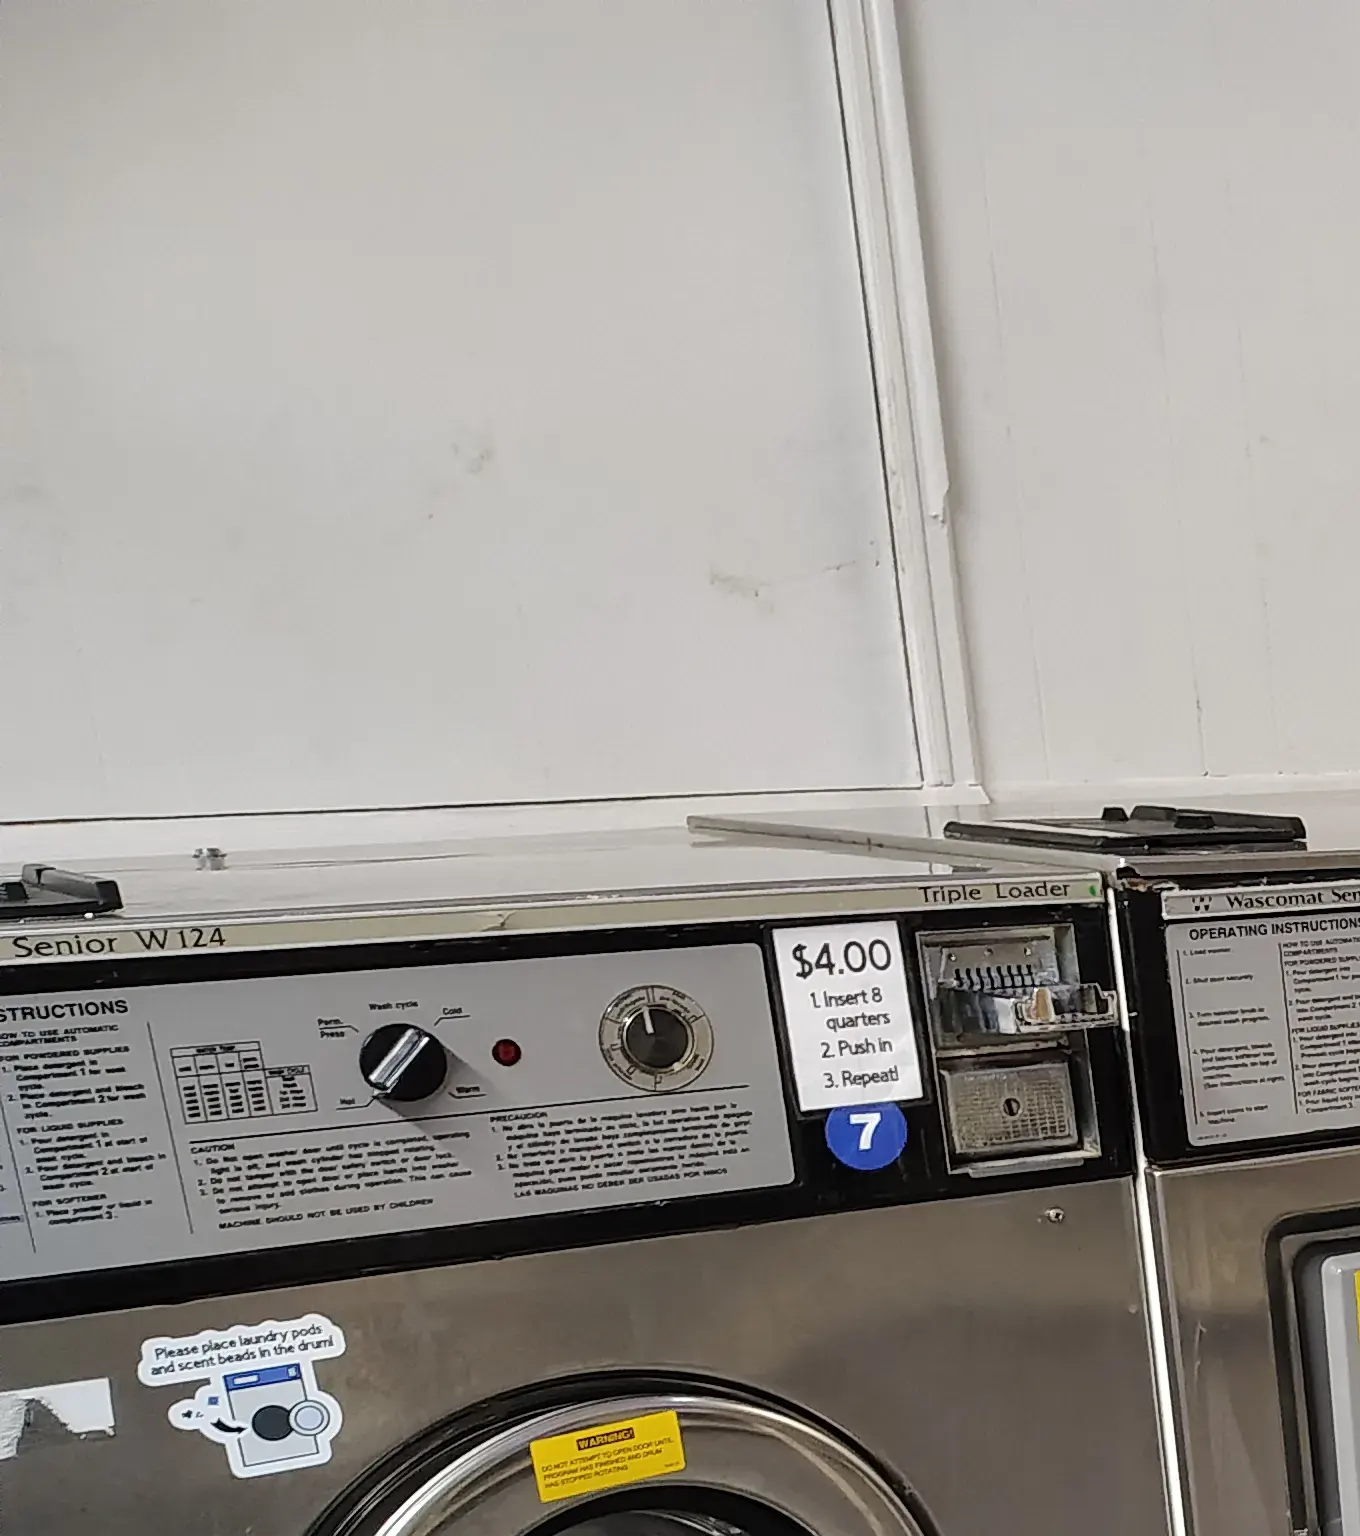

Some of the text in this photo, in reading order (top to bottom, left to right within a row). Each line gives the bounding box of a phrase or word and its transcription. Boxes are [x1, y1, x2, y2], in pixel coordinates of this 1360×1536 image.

[918, 881, 1071, 905] Triple Loader
[1226, 891, 1324, 910] Wascomat
[12, 927, 227, 958] Senior W 124
[1189, 923, 1268, 941] OPERATING
[792, 939, 893, 980] $4.00
[810, 987, 883, 1009] 1. Insert 8
[826, 1011, 891, 1031] quarters
[820, 1036, 893, 1059] 2. Push in
[823, 1066, 900, 1089] 3. Repeat!
[848, 1112, 881, 1151] 7
[154, 1324, 323, 1361] Please place laundry pods
[151, 1335, 335, 1376] and scent beads in the drum!
[577, 1428, 634, 1450] WARNING!
